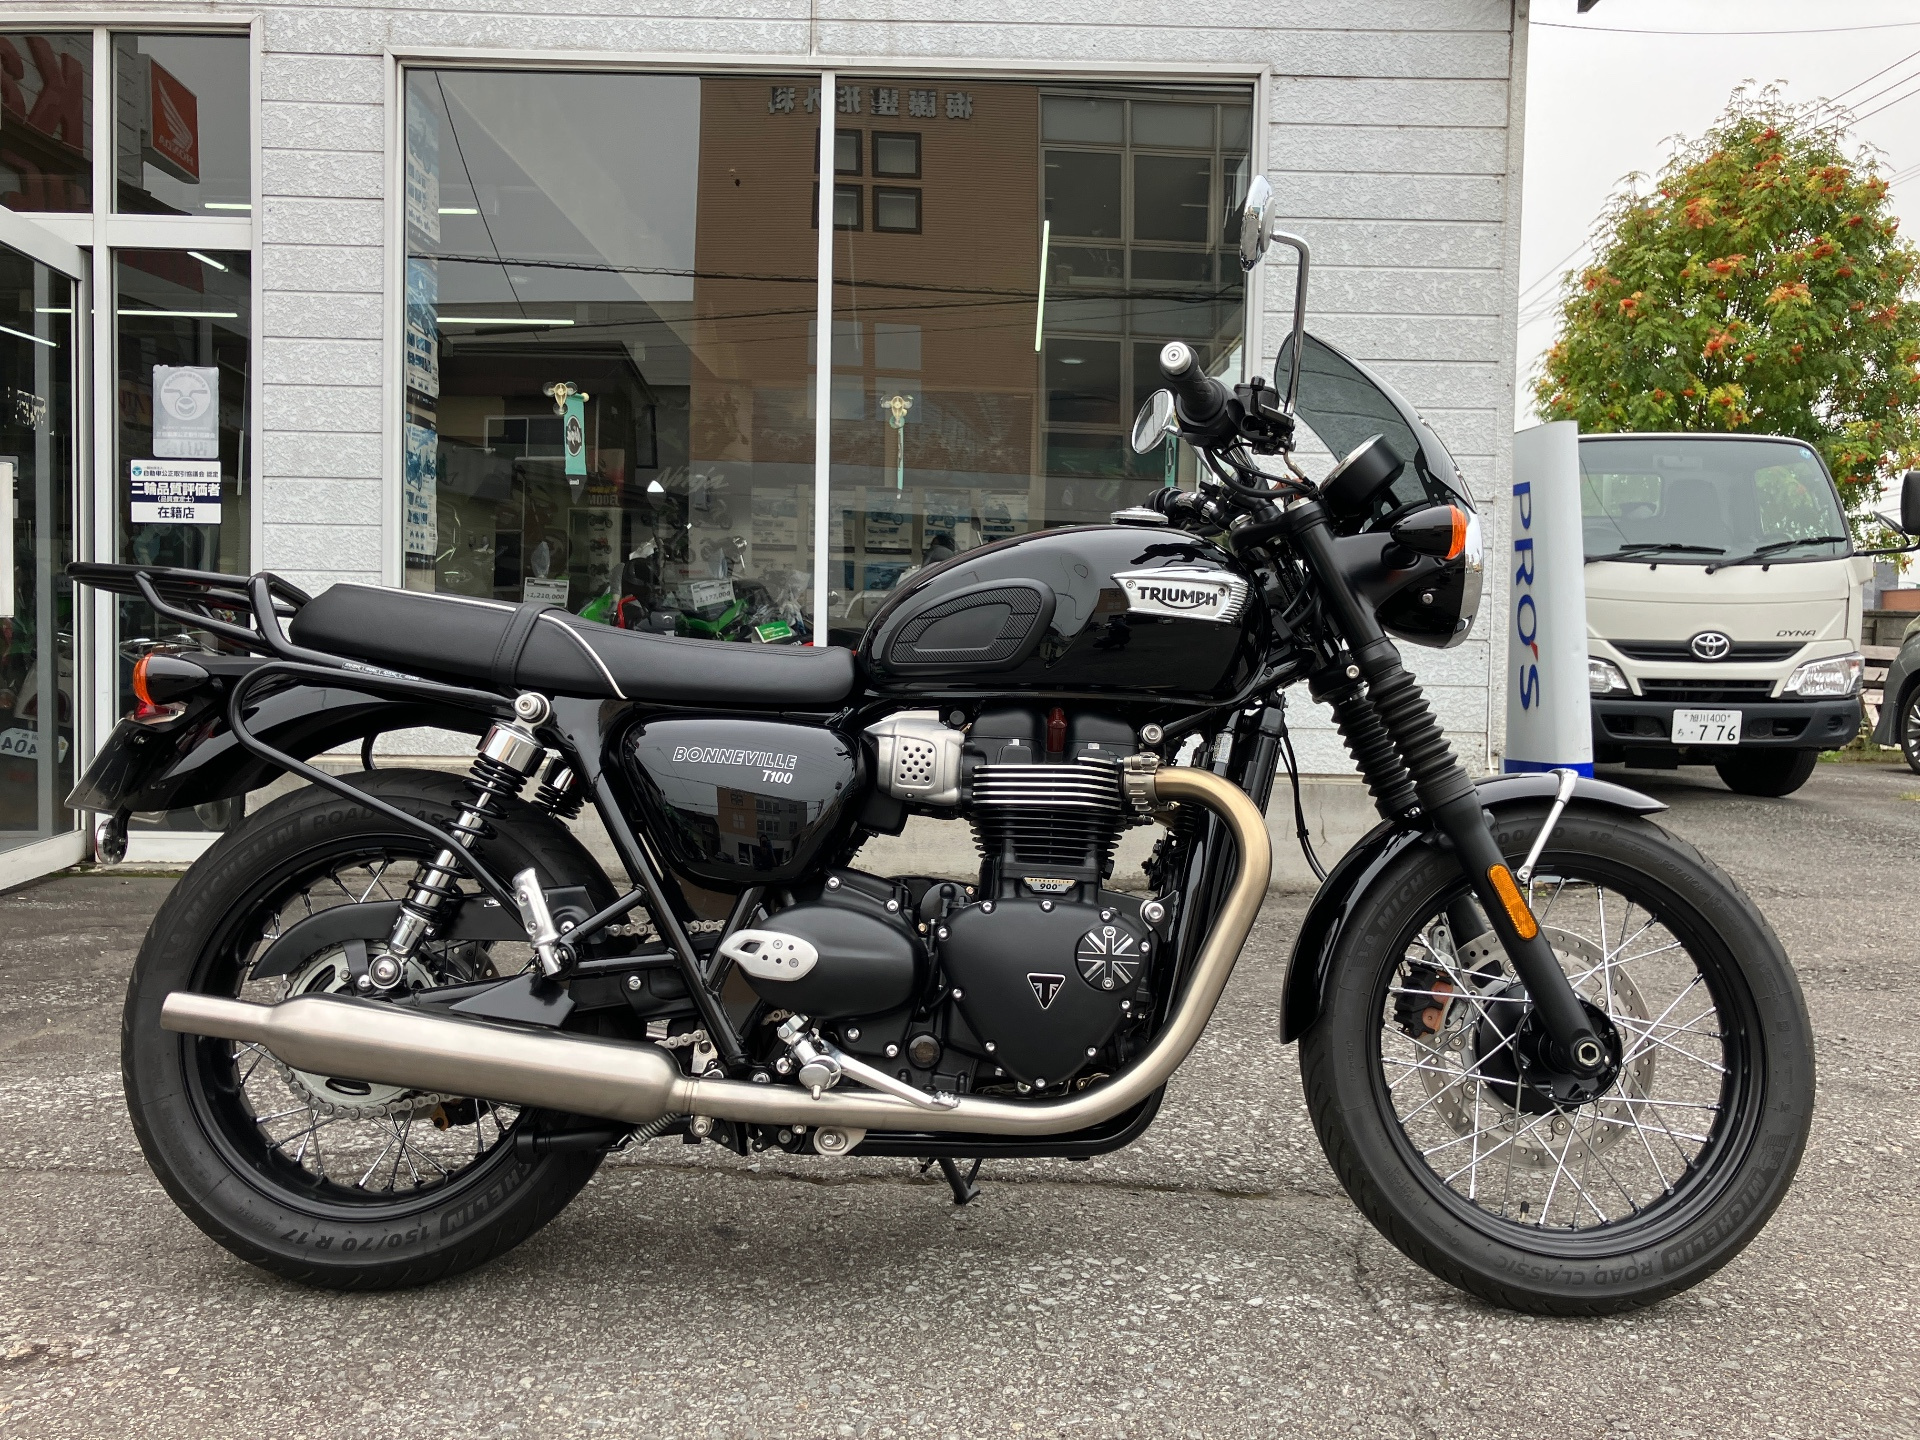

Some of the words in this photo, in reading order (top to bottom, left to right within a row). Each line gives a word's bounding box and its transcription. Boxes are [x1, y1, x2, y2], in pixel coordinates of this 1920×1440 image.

[131, 482, 221, 497] 二輪品質評価者
[157, 506, 195, 519] 在籍店
[1137, 586, 1218, 610] TRIUMPH
[1512, 480, 1540, 711] PRO'S
[1776, 629, 1817, 637] DYNA
[672, 746, 798, 770] BONNEVILLE
[762, 769, 794, 785] T100
[1376, 862, 1435, 930] MICHE
[1667, 1172, 1767, 1268] MICHELIN
[280, 1228, 310, 1245] 17
[314, 1234, 335, 1250] R
[341, 1225, 431, 1251] 150/70
[1493, 1255, 1586, 1286] CLASSIC
[1593, 1260, 1654, 1286] ROAD
